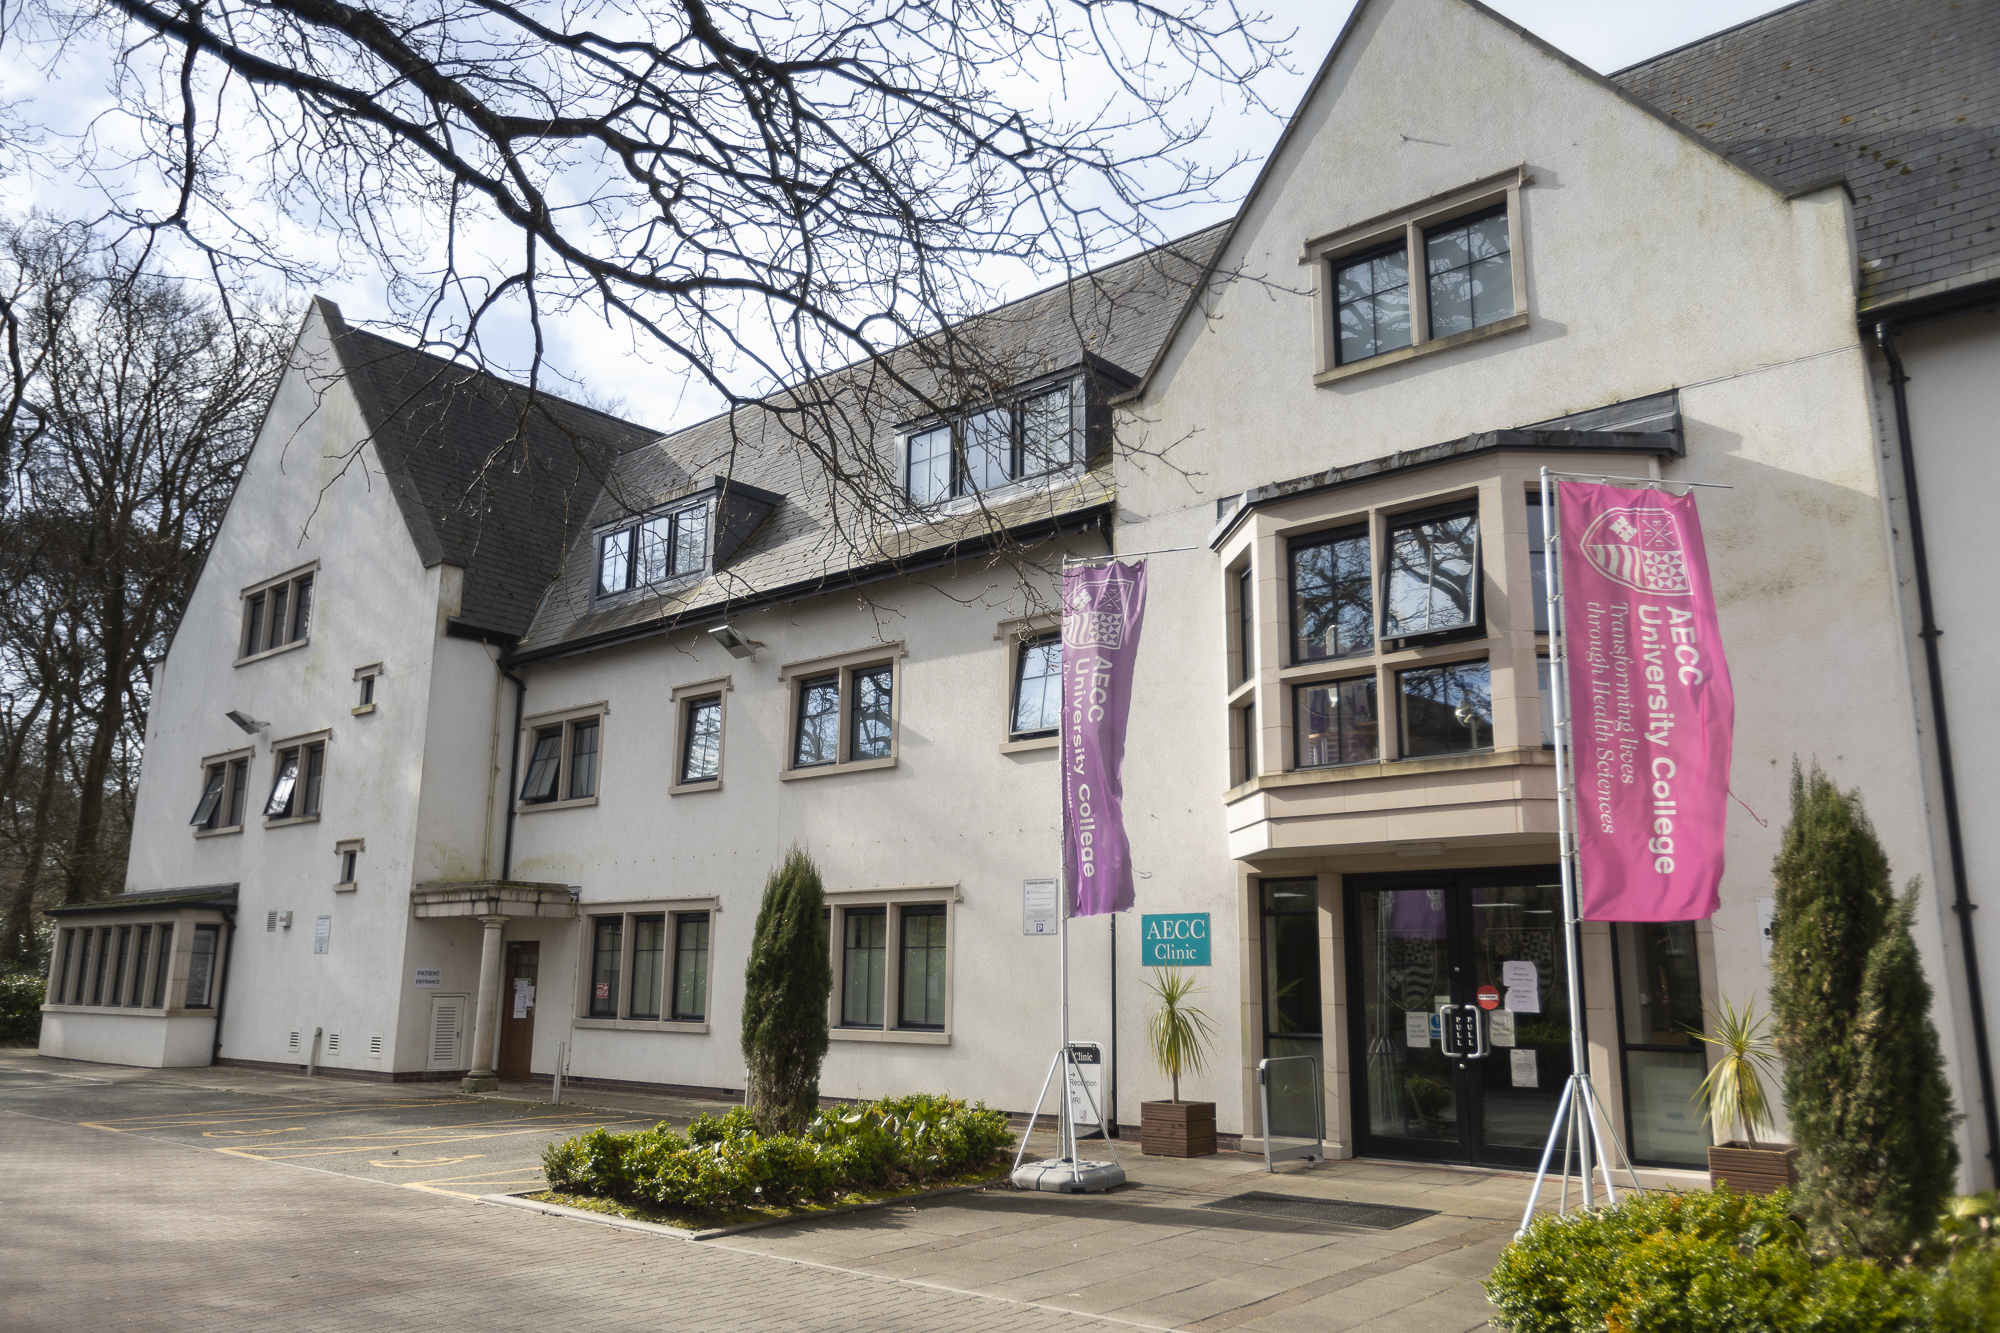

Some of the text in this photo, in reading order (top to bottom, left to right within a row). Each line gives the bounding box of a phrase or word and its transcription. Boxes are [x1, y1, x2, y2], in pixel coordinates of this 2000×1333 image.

[1666, 605, 1704, 686] AECC
[1072, 658, 1091, 776] University
[1087, 655, 1113, 723] AECC
[1585, 601, 1615, 835] through Health Sciences
[1608, 601, 1639, 785] Transforming lives
[1638, 606, 1676, 875] University College
[1147, 919, 1206, 940] AECC
[1154, 943, 1197, 961] Clinic
[1074, 1051, 1094, 1062] Clinic
[1455, 1016, 1463, 1047] PULL
[1466, 1016, 1474, 1046] PULL
